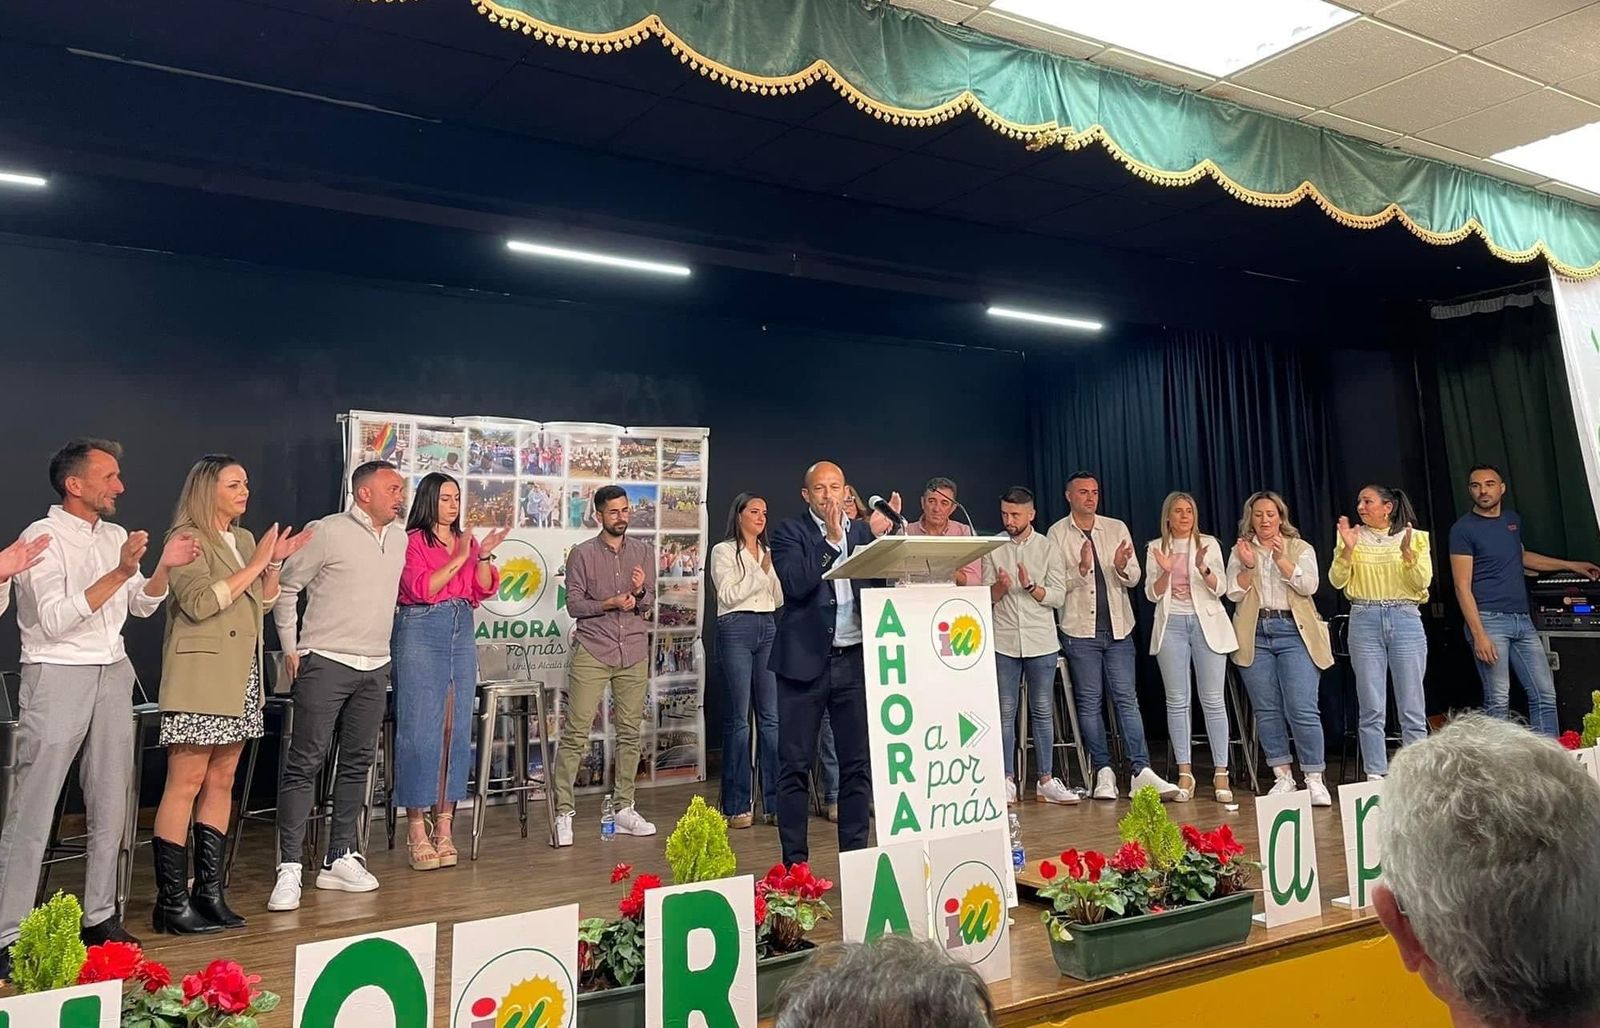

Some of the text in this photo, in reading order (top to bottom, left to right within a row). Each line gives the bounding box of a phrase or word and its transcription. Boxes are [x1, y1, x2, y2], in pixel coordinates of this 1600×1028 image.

[474, 620, 561, 639] AHORA
[938, 621, 975, 657] iu
[875, 598, 921, 836] AHORA
[924, 725, 948, 750] a
[927, 754, 985, 799] por
[930, 788, 1003, 829] más
[1268, 808, 1315, 906] a
[944, 898, 991, 949] iu
